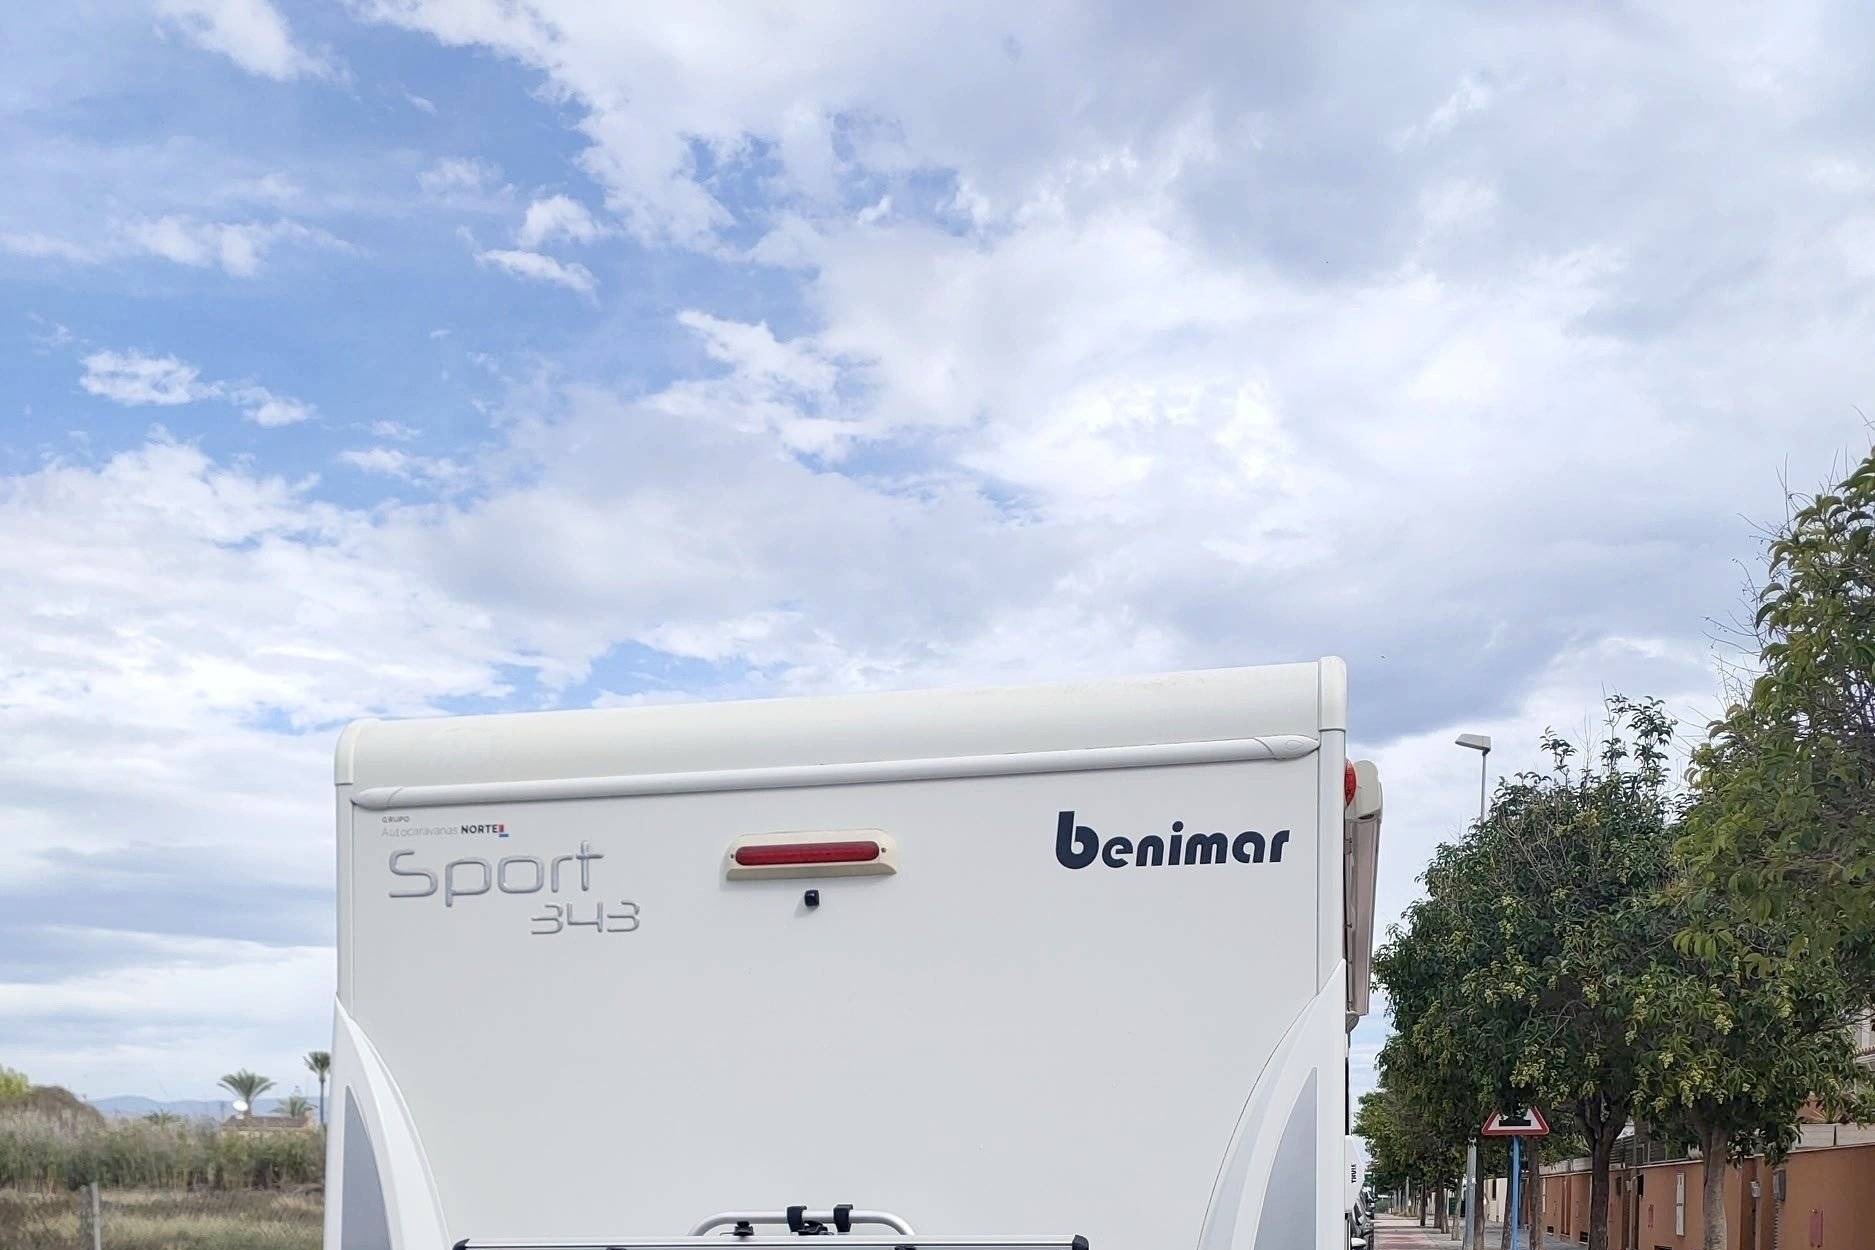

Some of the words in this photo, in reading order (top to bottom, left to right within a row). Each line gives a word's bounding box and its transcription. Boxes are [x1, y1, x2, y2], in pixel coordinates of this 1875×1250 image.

[460, 824, 498, 834] NORTE
[1055, 810, 1291, 869] benimar
[389, 840, 605, 908] Sport
[531, 900, 641, 935] 343
